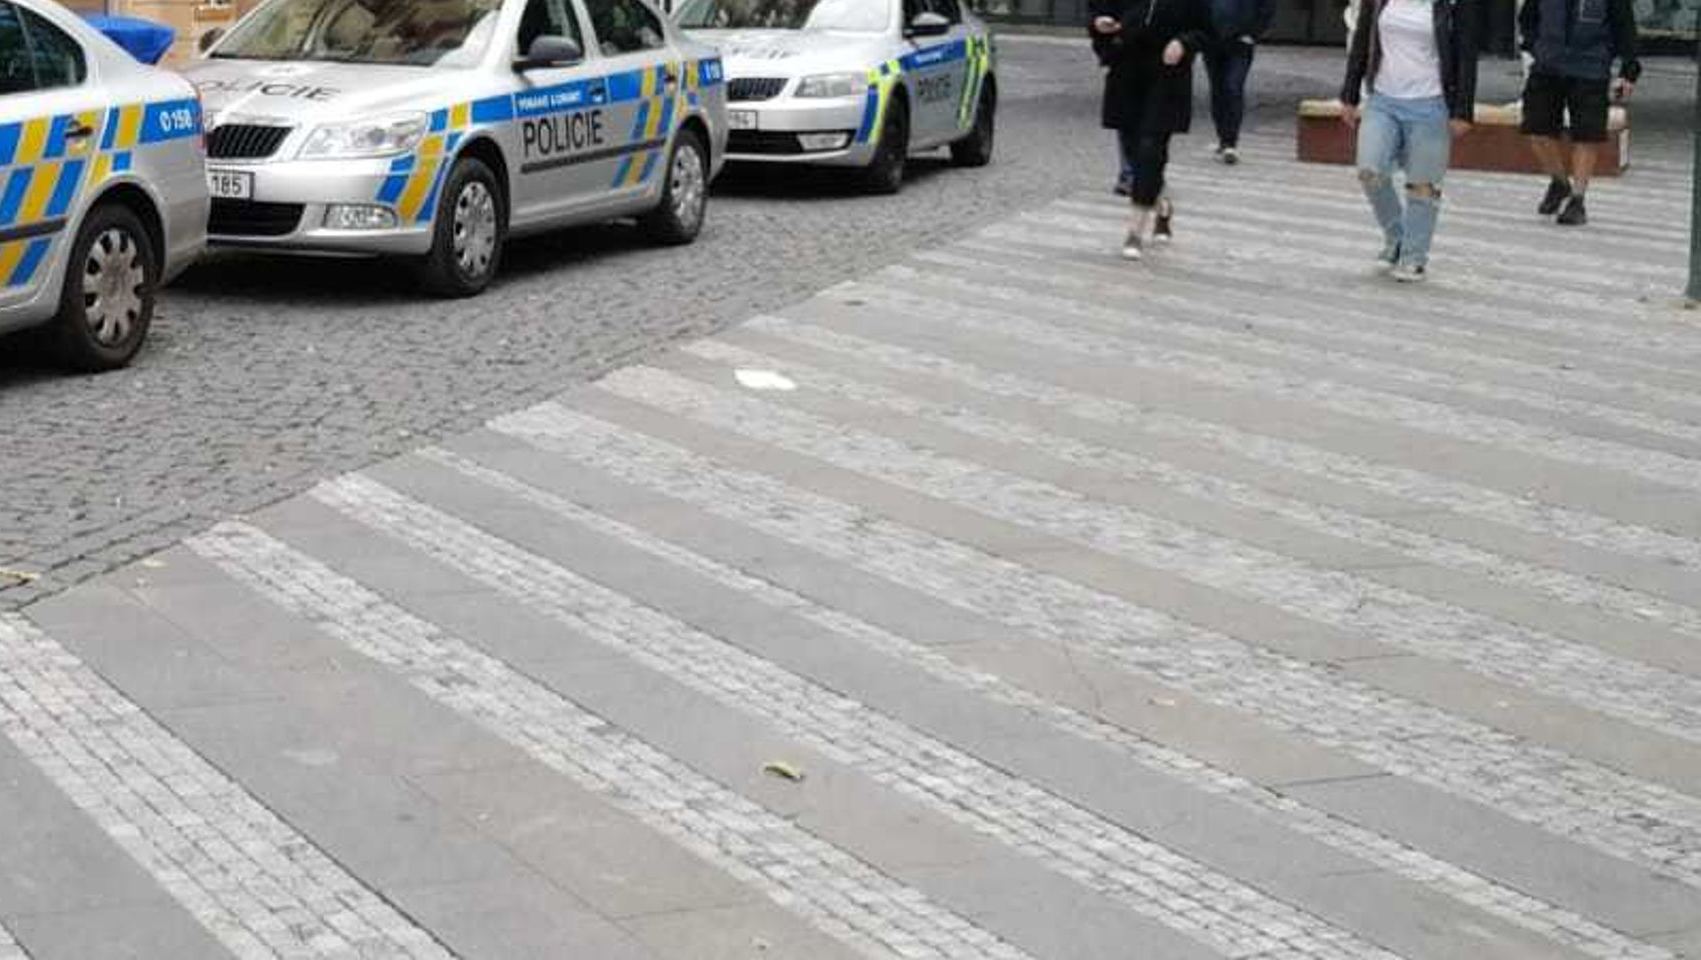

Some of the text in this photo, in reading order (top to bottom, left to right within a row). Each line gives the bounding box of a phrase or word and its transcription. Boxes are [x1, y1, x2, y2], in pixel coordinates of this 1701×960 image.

[197, 80, 341, 102] OLICIE
[523, 109, 604, 158] POLICIE
[211, 176, 242, 196] 185
